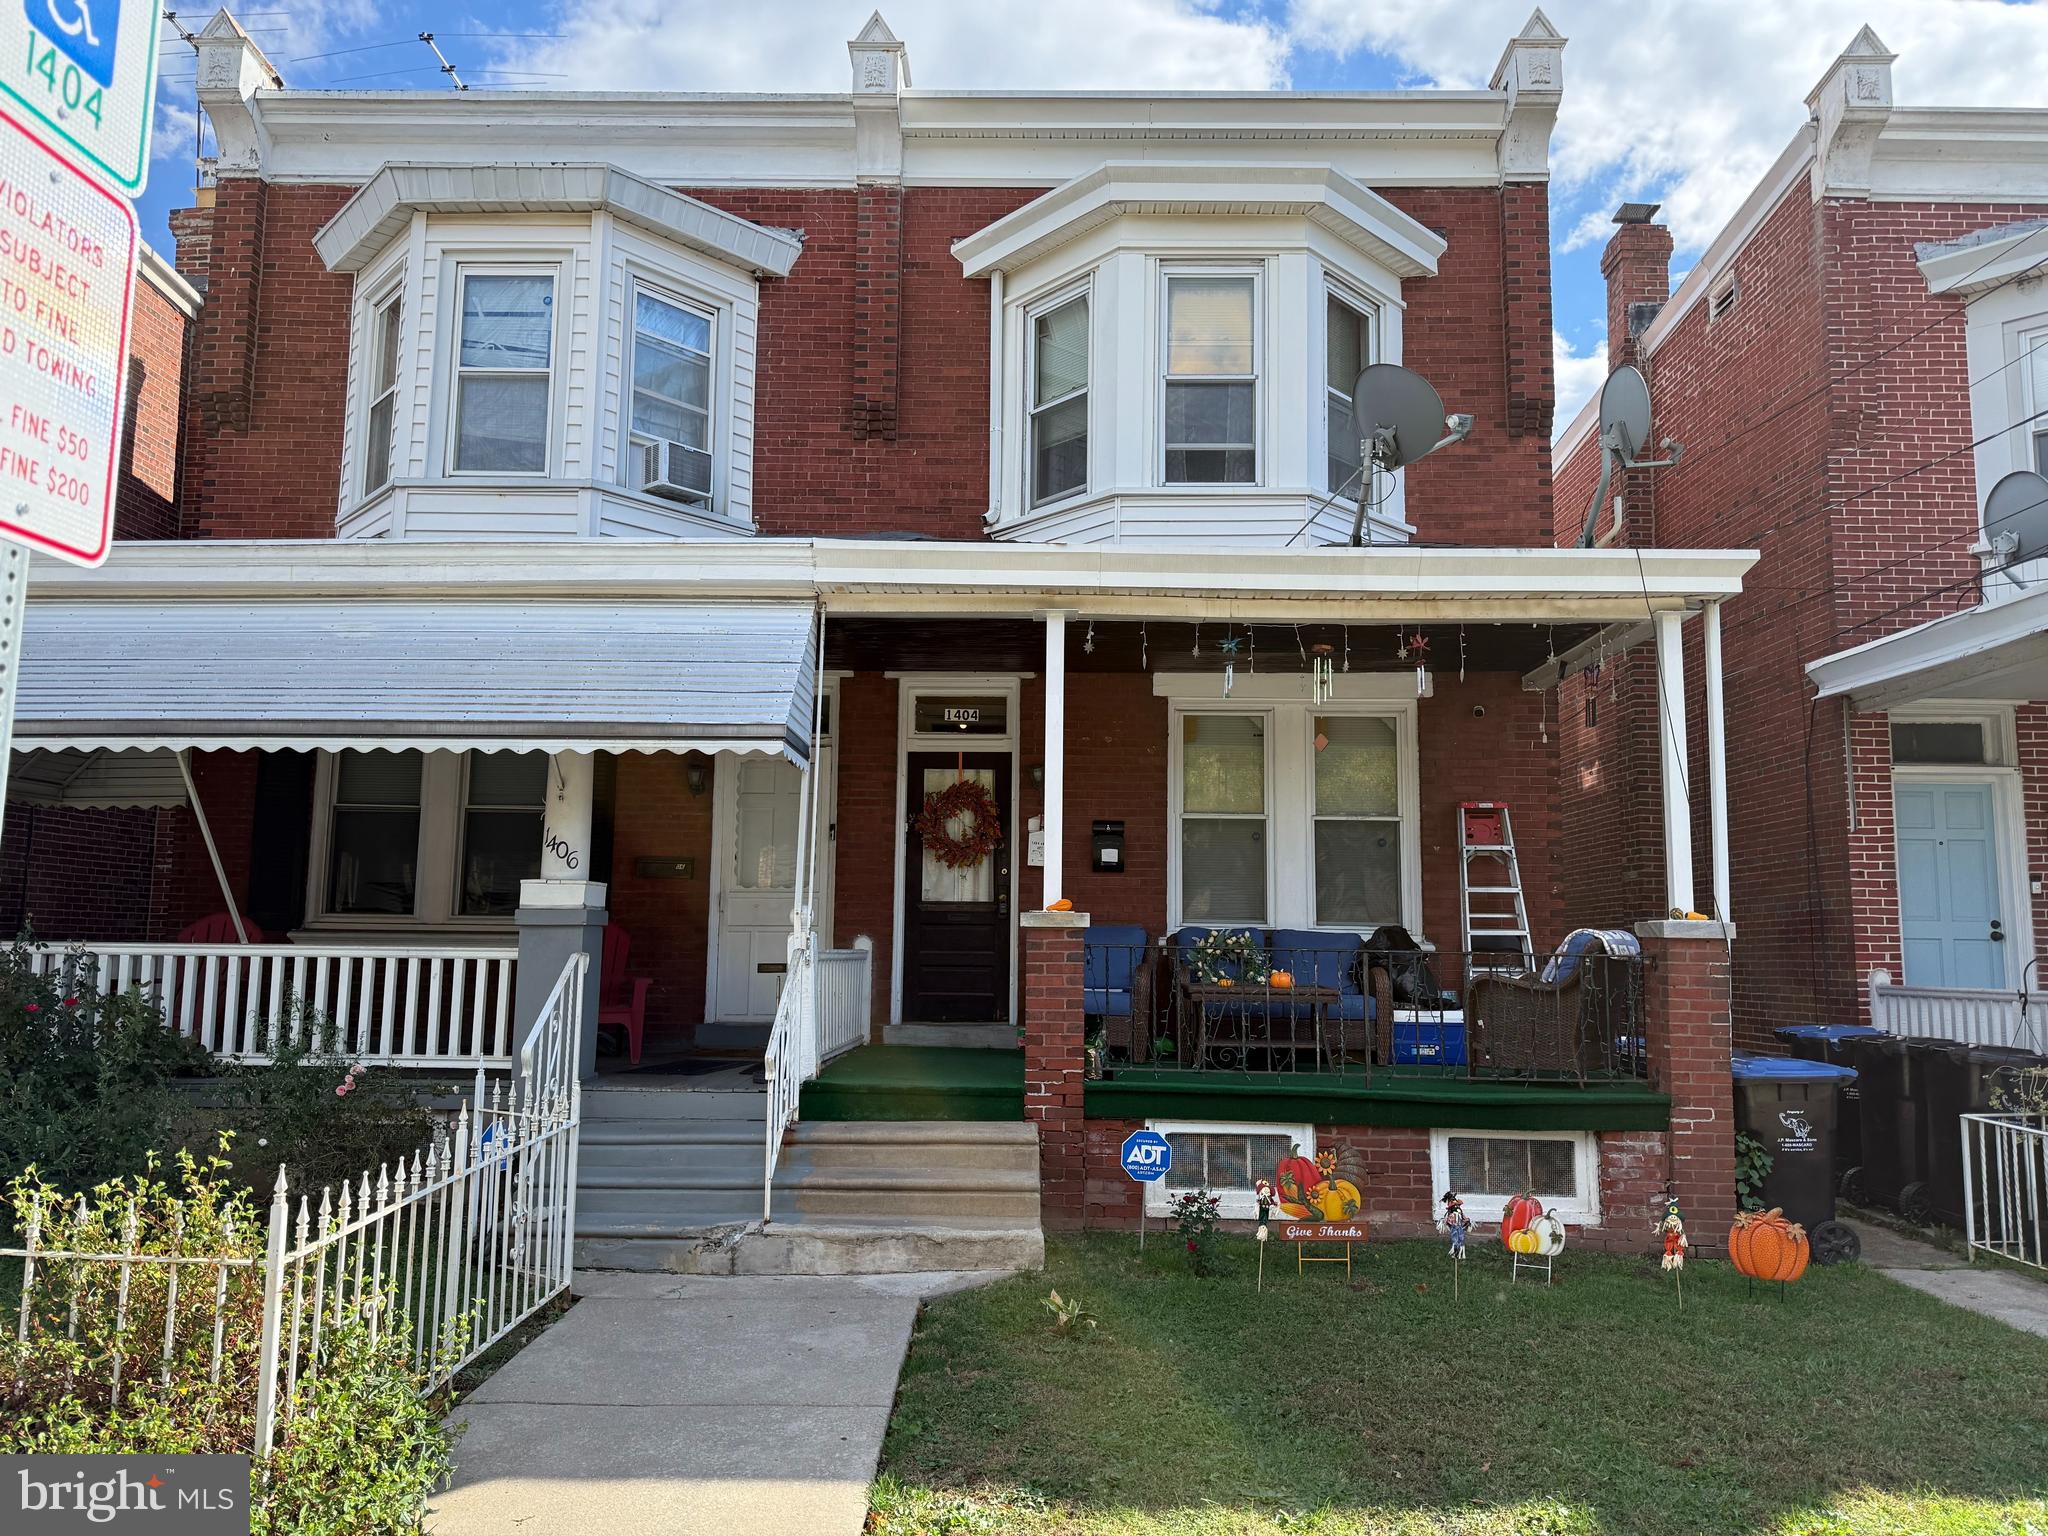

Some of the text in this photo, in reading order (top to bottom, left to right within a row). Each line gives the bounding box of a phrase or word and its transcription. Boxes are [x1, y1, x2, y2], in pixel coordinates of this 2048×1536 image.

[27, 30, 103, 131] 1404
[0, 229, 91, 304] SUBJECT
[1, 276, 26, 313] TO
[36, 299, 80, 347] FINE
[26, 338, 97, 398] TOWING
[12, 404, 88, 461] FINE $50
[0, 446, 89, 506] FINE $200
[946, 709, 978, 721] 1404
[544, 826, 579, 870] 1406
[1127, 1145, 1167, 1165] ADT
[1286, 1225, 1362, 1239] Give Thanks
